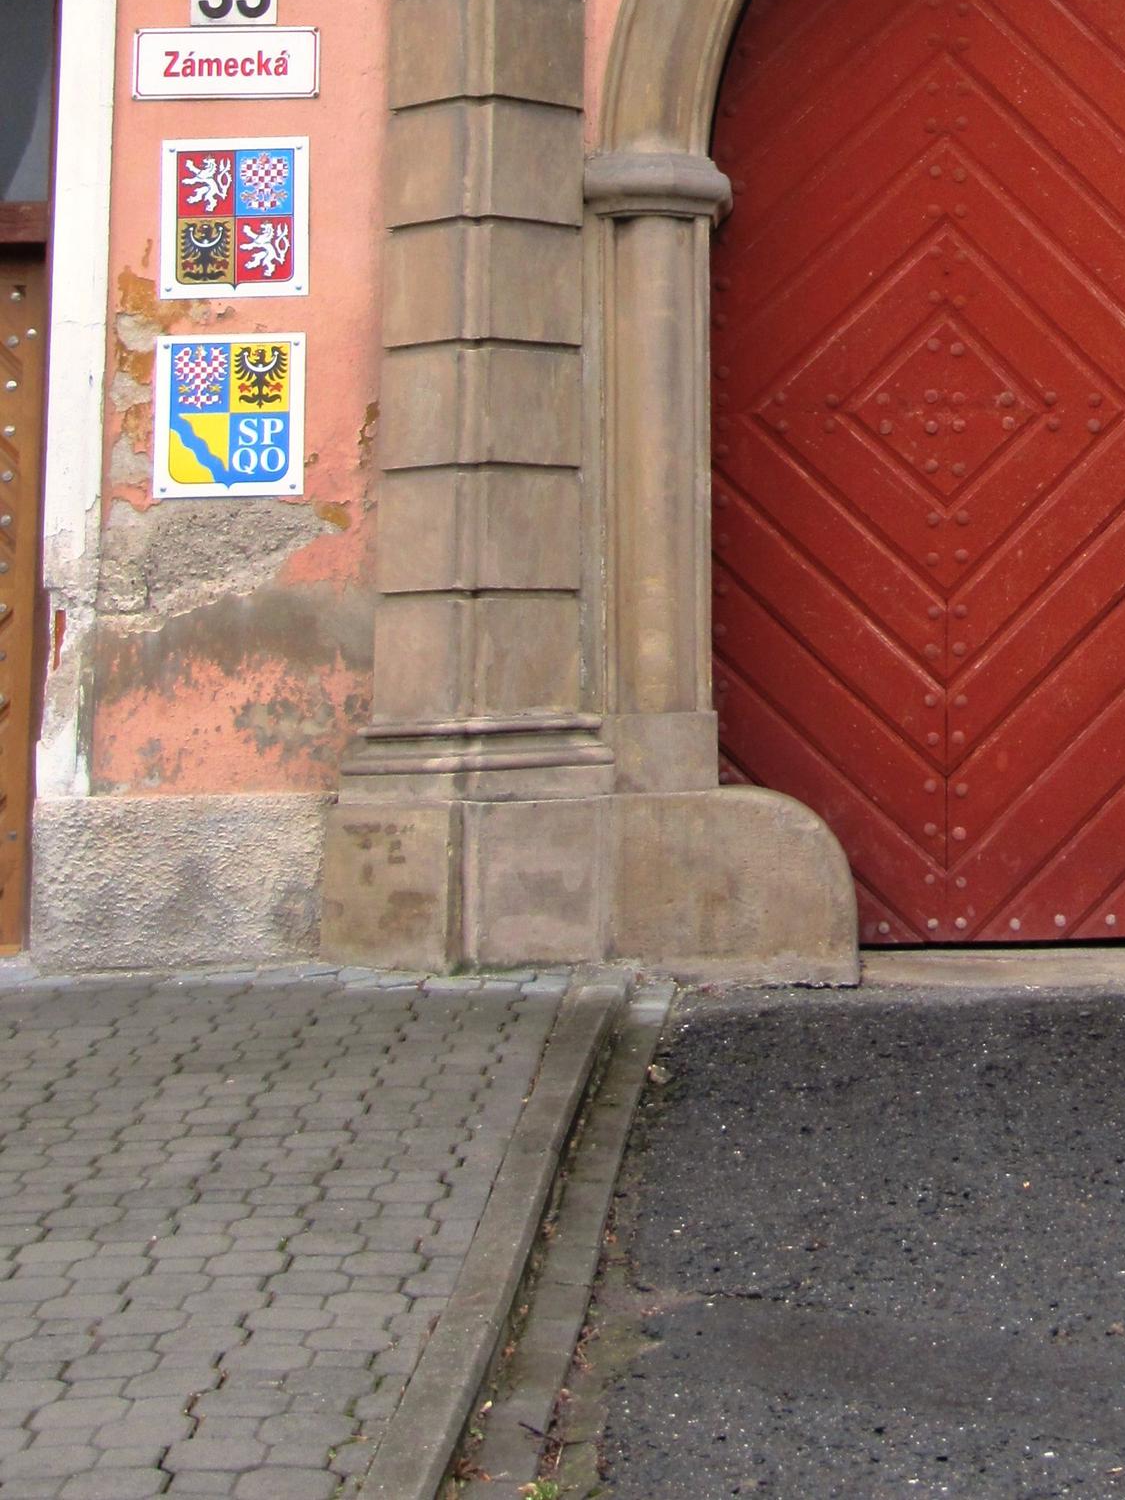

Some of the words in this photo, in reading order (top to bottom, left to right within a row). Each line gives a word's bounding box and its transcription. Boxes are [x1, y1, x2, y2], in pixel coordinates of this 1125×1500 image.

[163, 50, 289, 78] Zámecká
[238, 417, 284, 446] SP
[232, 447, 286, 474] QO
